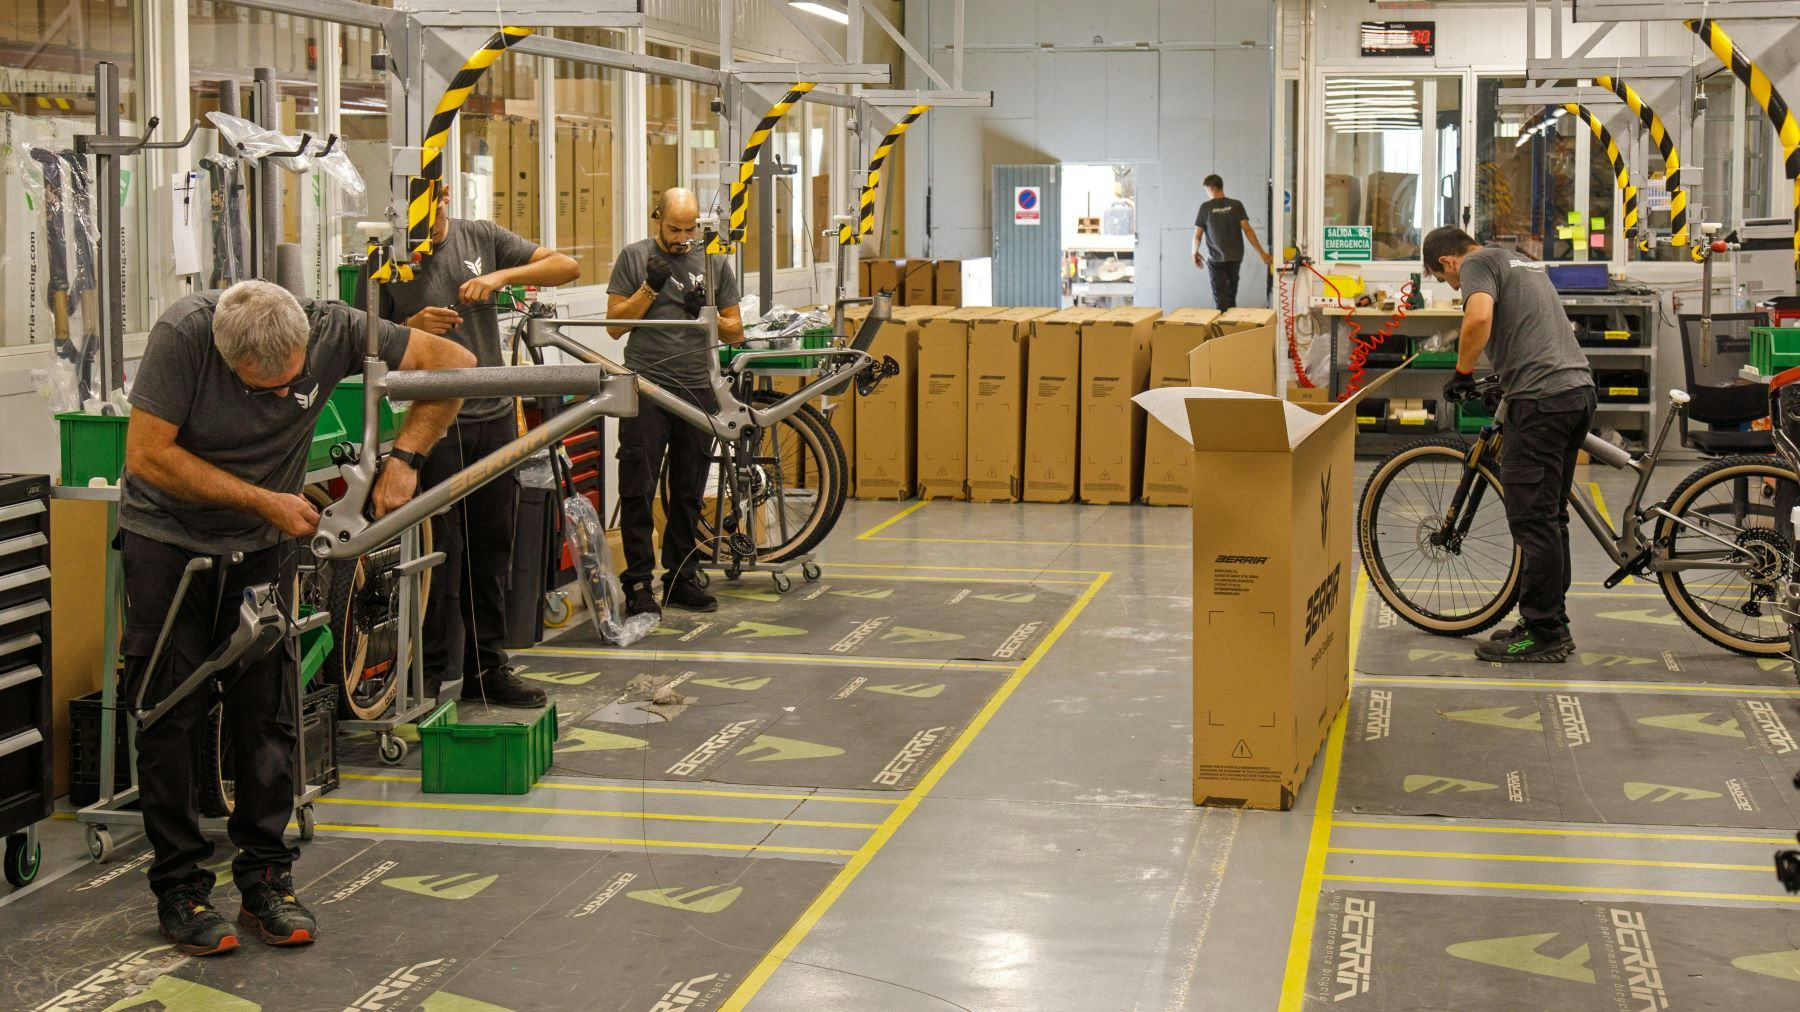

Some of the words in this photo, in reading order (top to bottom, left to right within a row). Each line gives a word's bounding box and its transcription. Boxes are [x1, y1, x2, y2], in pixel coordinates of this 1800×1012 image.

[1325, 239, 1370, 249] EMERGENCIA
[1327, 228, 1352, 238] SALIDA
[1358, 228, 1368, 238] DE
[1214, 554, 1268, 565] BERRIA
[1304, 562, 1341, 647] BERRIA
[1556, 694, 1591, 747] BERRIA
[664, 719, 758, 776] BERRIA
[872, 726, 946, 785] BERRIA
[1324, 913, 1339, 965] performance
[1333, 897, 1376, 1002] BERRIA
[1600, 926, 1621, 981] performance
[412, 957, 459, 992] bicycle
[695, 972, 733, 1008] bicycle
